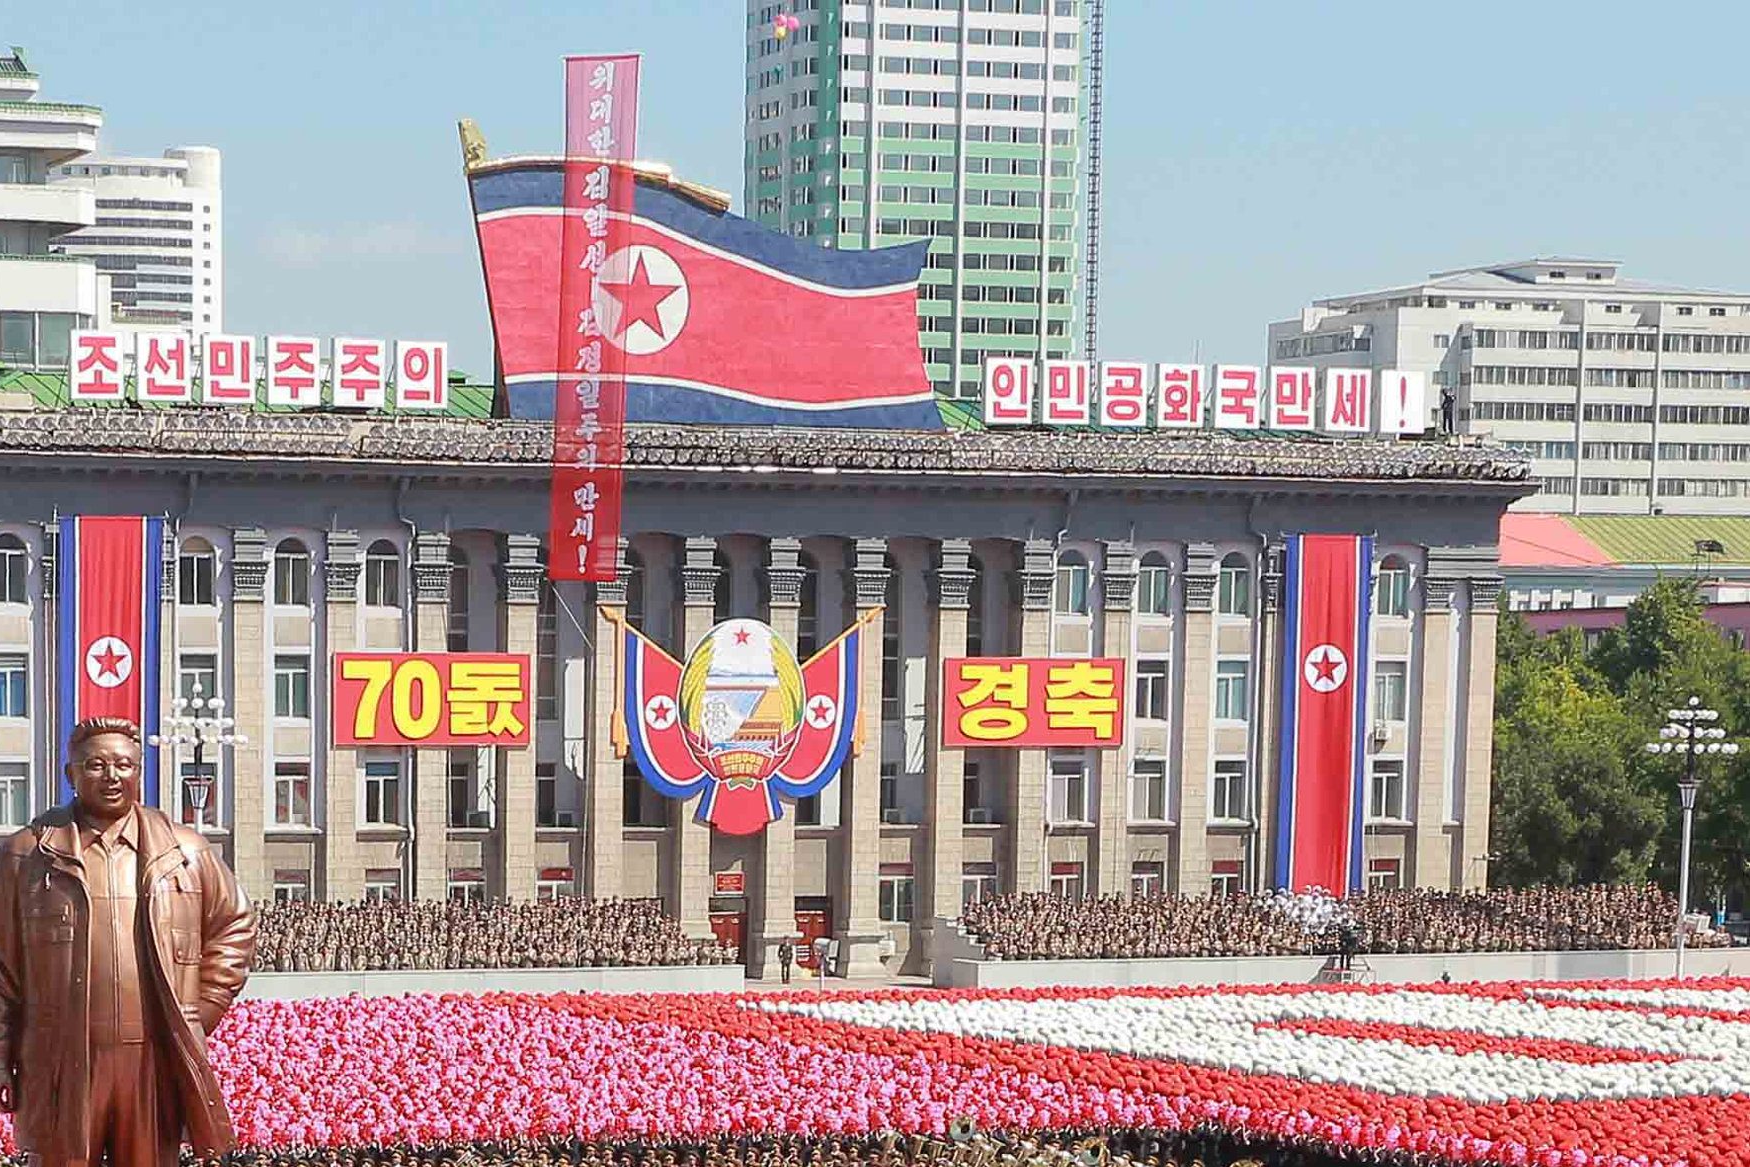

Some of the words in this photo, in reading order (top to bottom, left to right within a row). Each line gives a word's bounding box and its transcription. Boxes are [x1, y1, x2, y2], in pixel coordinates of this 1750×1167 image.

[588, 61, 616, 156] 위대한
[77, 336, 442, 404] 조선민주주의
[569, 481, 600, 575] 만세!
[341, 657, 524, 738] 70돐
[956, 662, 1120, 740] 경축
